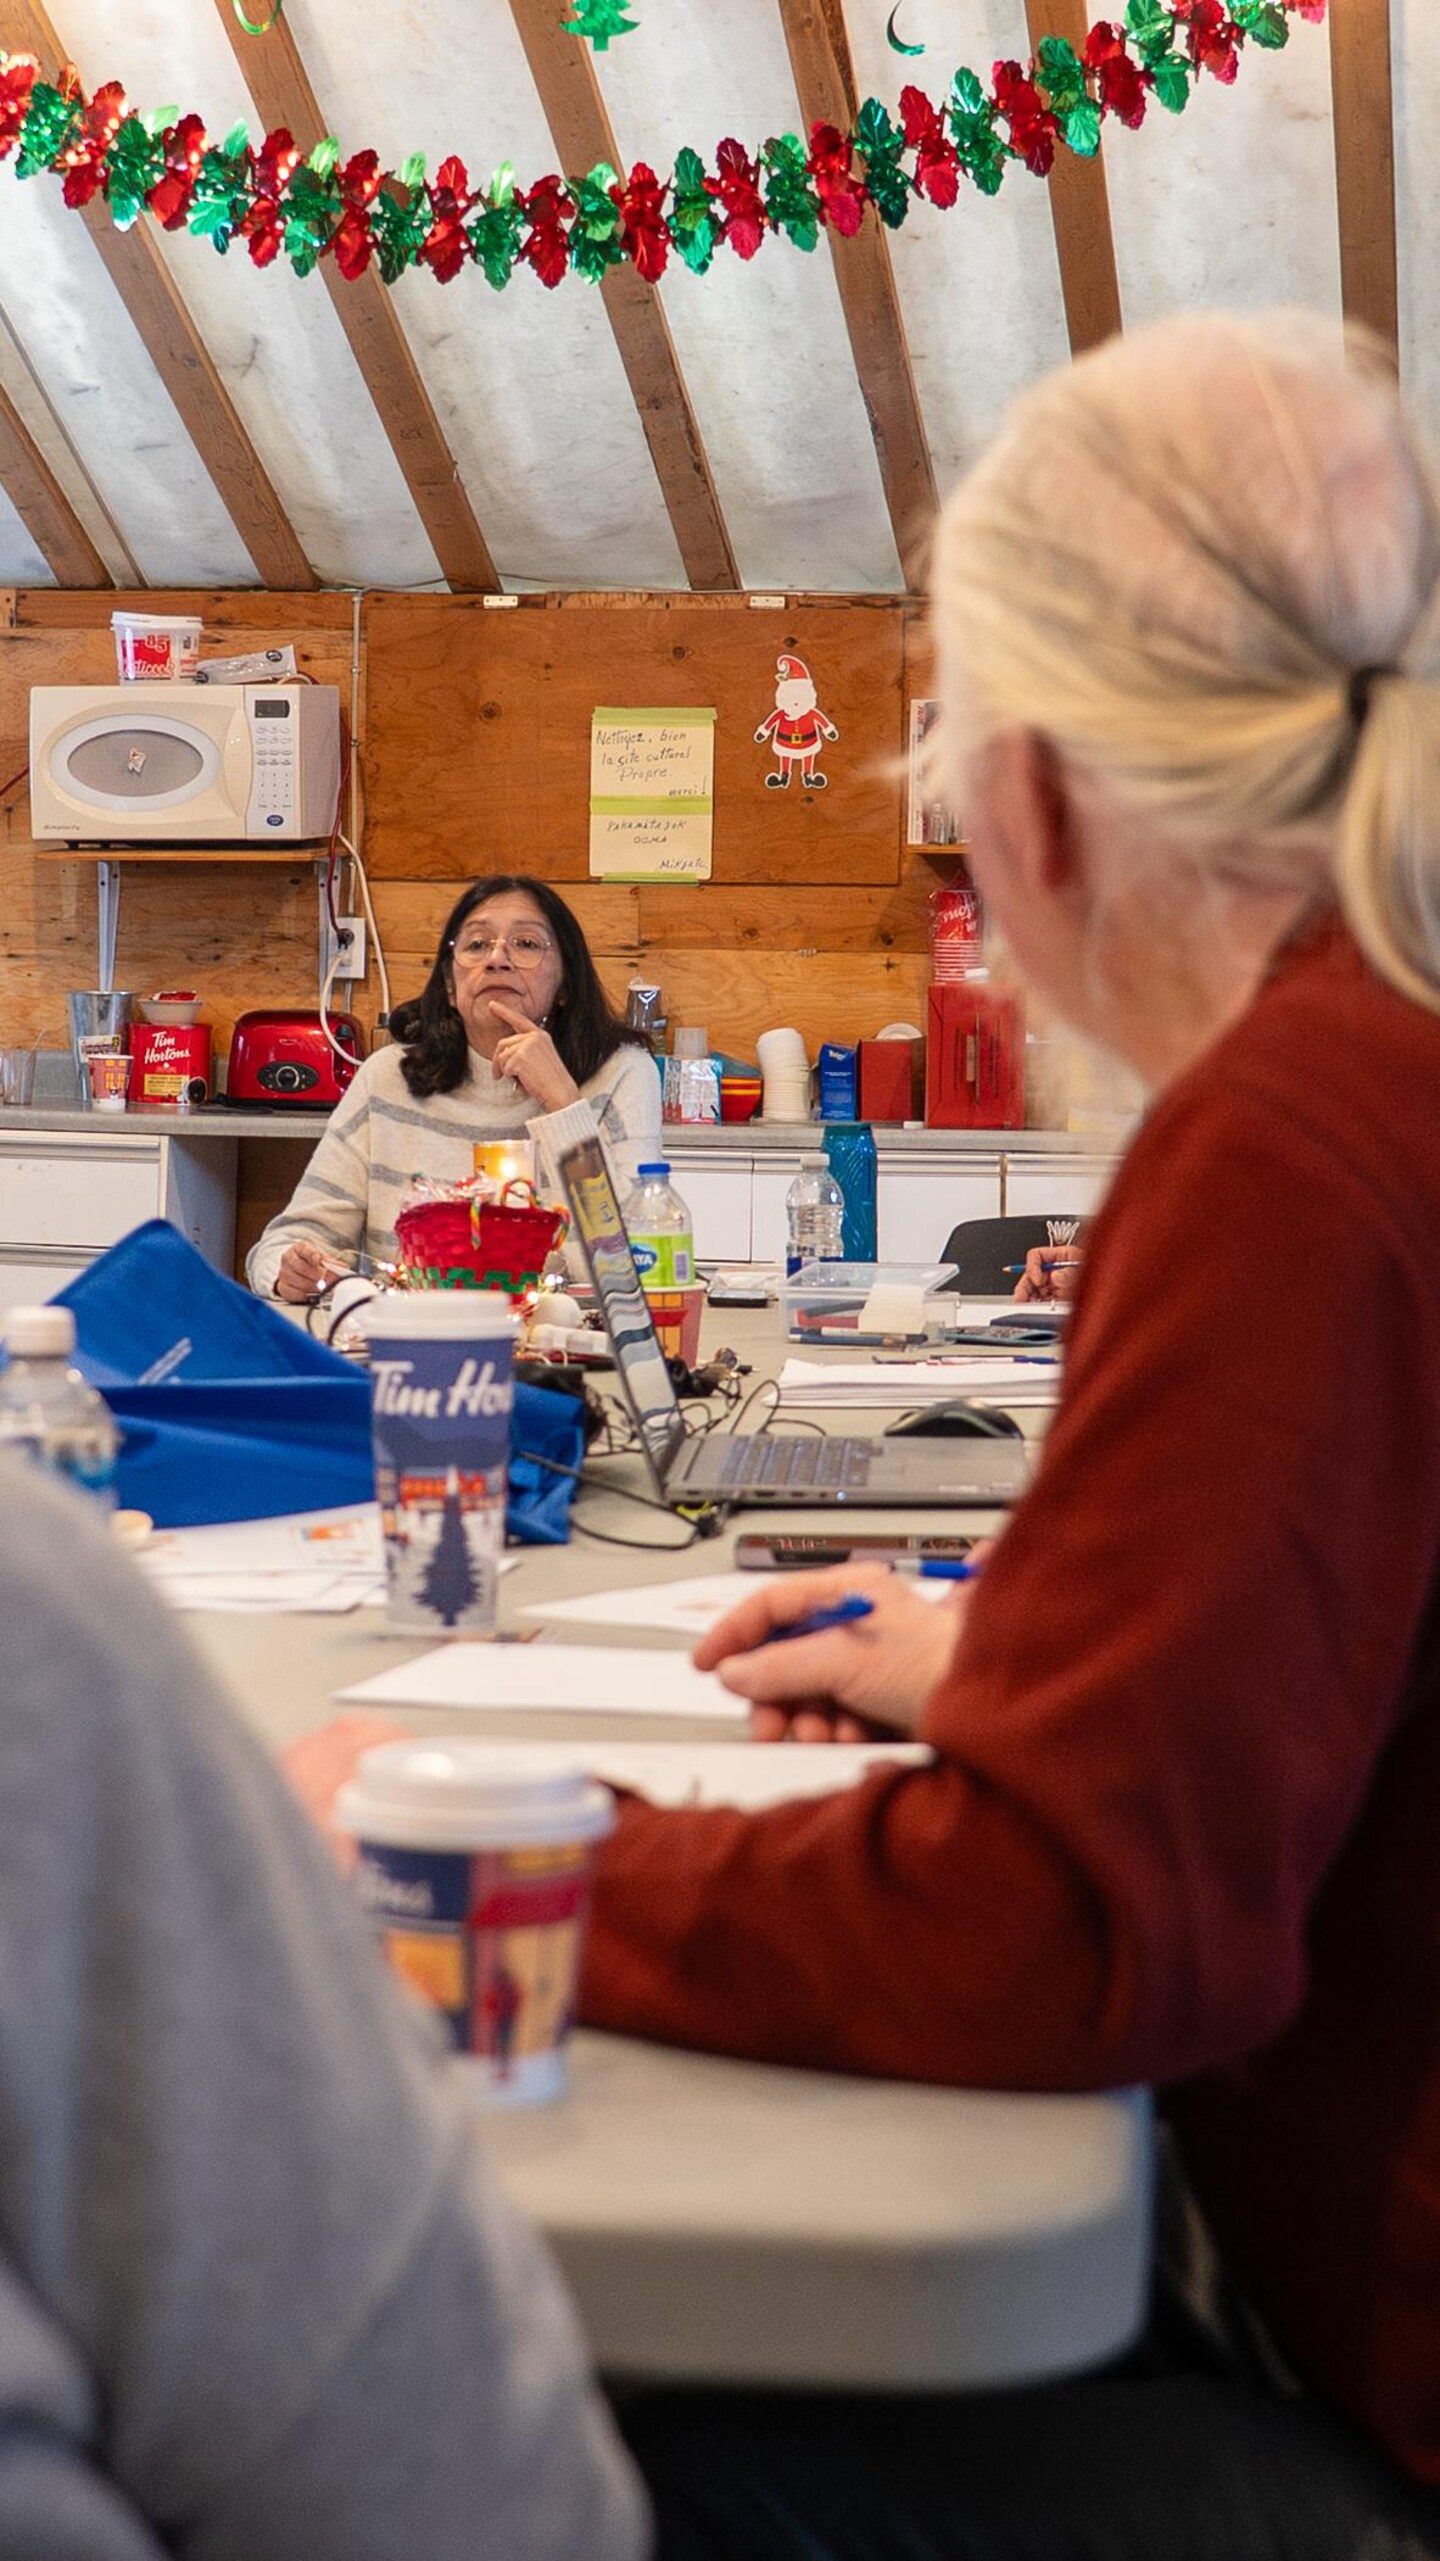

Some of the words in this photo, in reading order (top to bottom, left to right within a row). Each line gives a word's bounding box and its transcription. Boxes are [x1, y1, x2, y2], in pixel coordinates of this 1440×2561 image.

[660, 728, 687, 742] bien
[602, 752, 614, 766] la
[151, 1031, 175, 1048] Tim
[144, 1047, 191, 1064] Hortons
[371, 1360, 441, 1419] Tim
